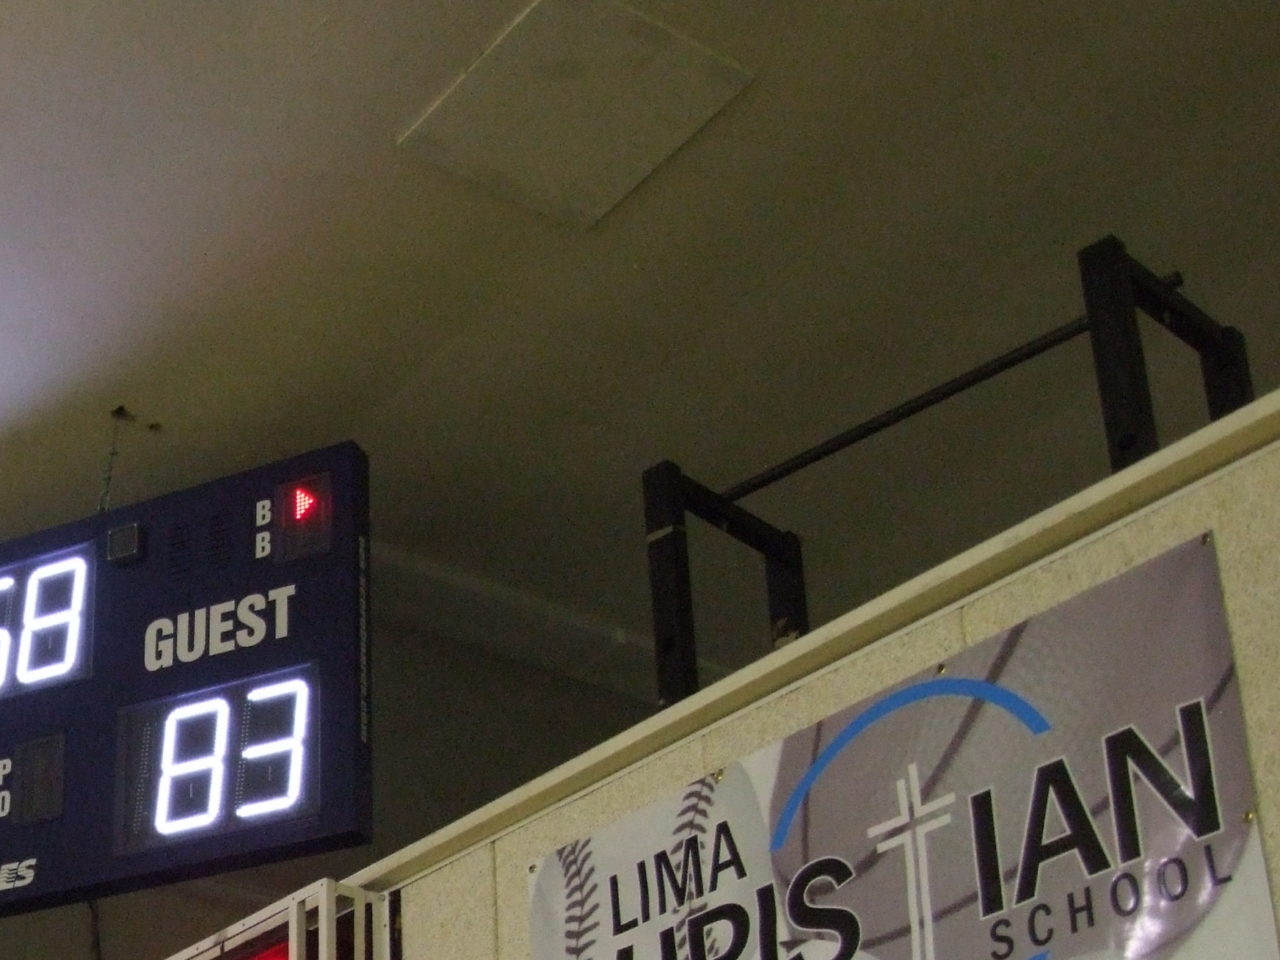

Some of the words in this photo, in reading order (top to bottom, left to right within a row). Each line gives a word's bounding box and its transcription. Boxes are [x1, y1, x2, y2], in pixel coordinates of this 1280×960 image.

[255, 531, 271, 559] B
[256, 500, 271, 527] B
[144, 584, 297, 672] GUEST
[155, 679, 310, 835] 83
[609, 820, 747, 936] LIMA
